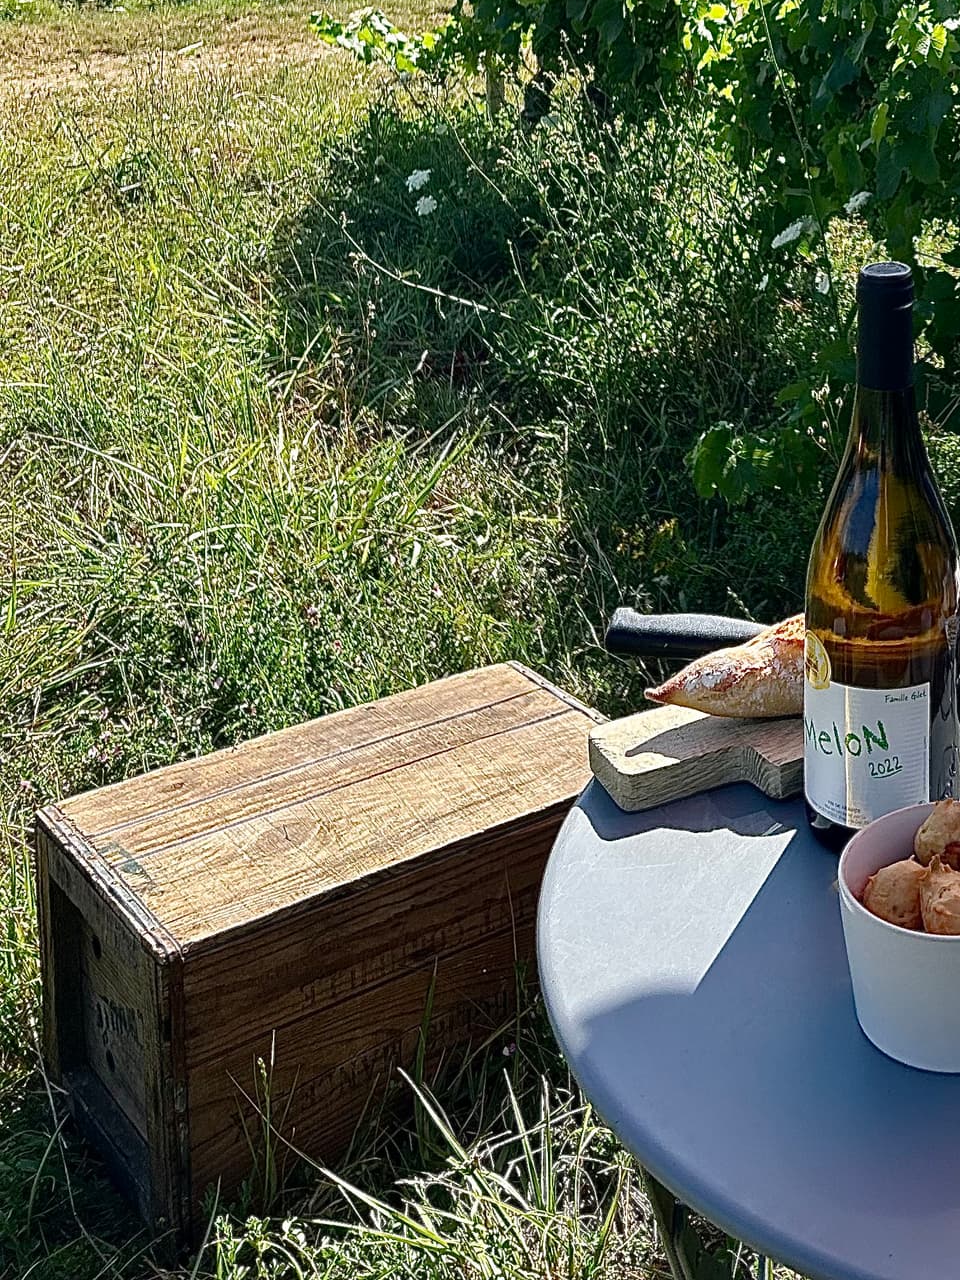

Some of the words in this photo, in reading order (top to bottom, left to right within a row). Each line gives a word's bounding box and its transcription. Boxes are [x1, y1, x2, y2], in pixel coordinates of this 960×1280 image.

[884, 693, 908, 704] Famille
[911, 690, 927, 701] Gilet
[868, 756, 903, 777] 2022
